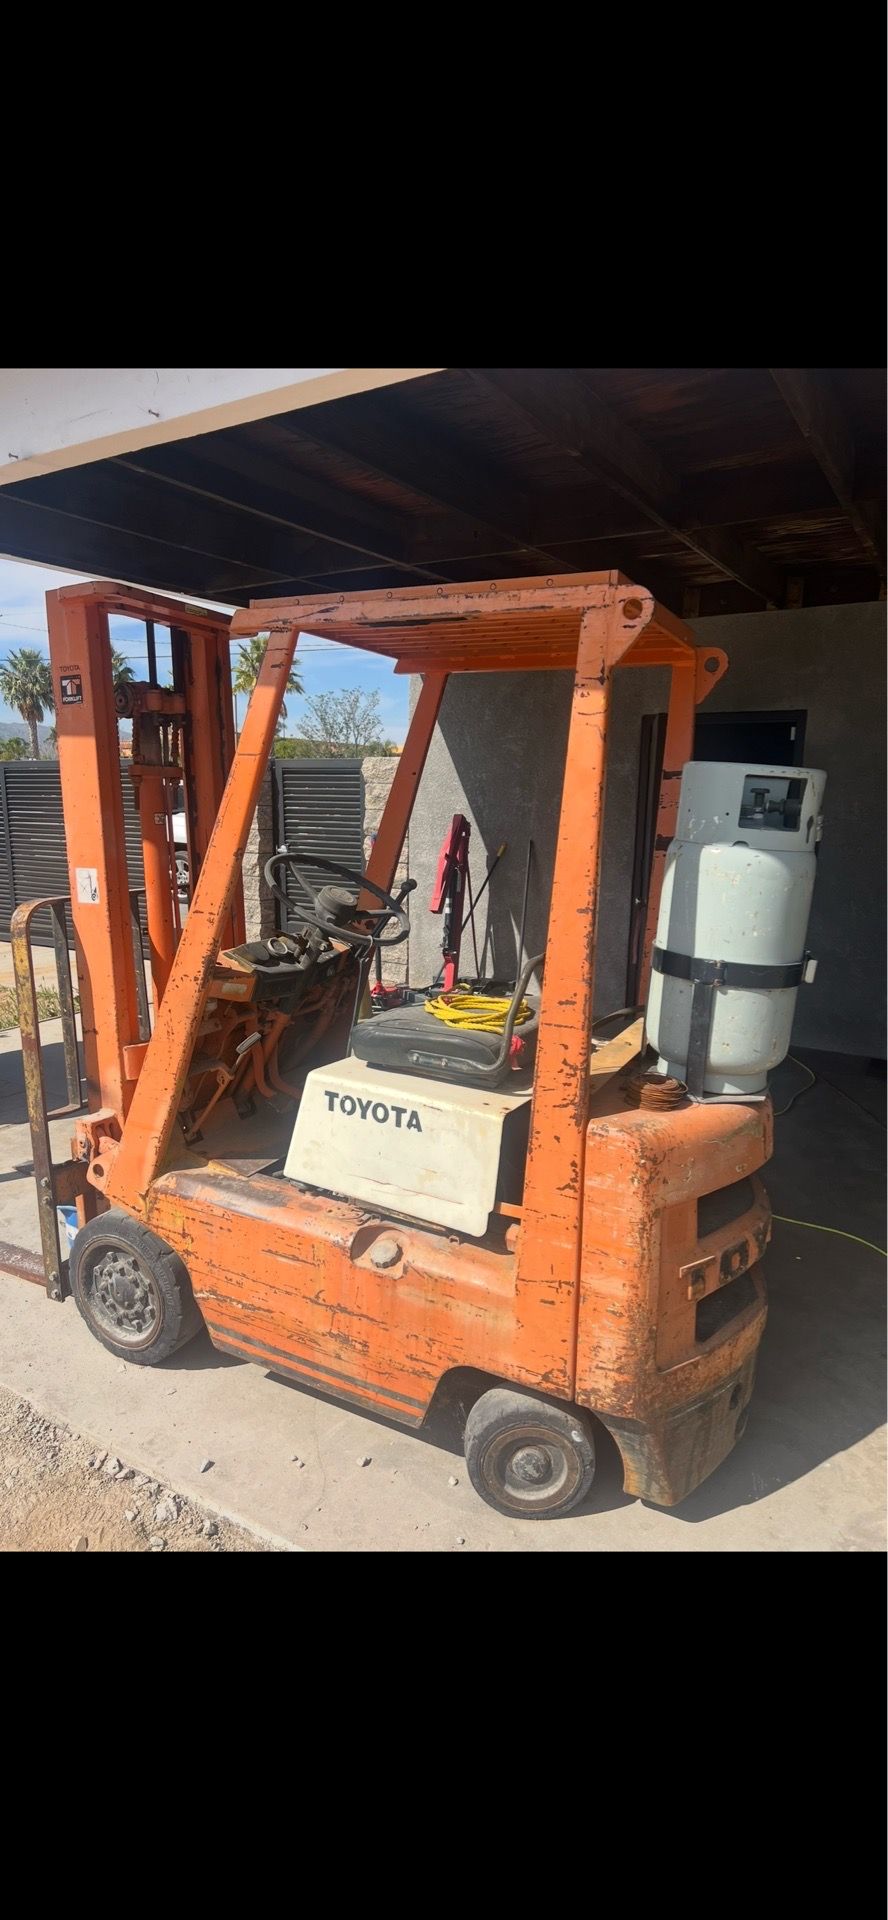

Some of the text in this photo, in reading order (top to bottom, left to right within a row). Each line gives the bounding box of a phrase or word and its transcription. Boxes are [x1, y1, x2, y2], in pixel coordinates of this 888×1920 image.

[59, 664, 80, 673] TOYOTA
[62, 695, 82, 703] FORKLIFT
[324, 1090, 423, 1133] TOYOTA
